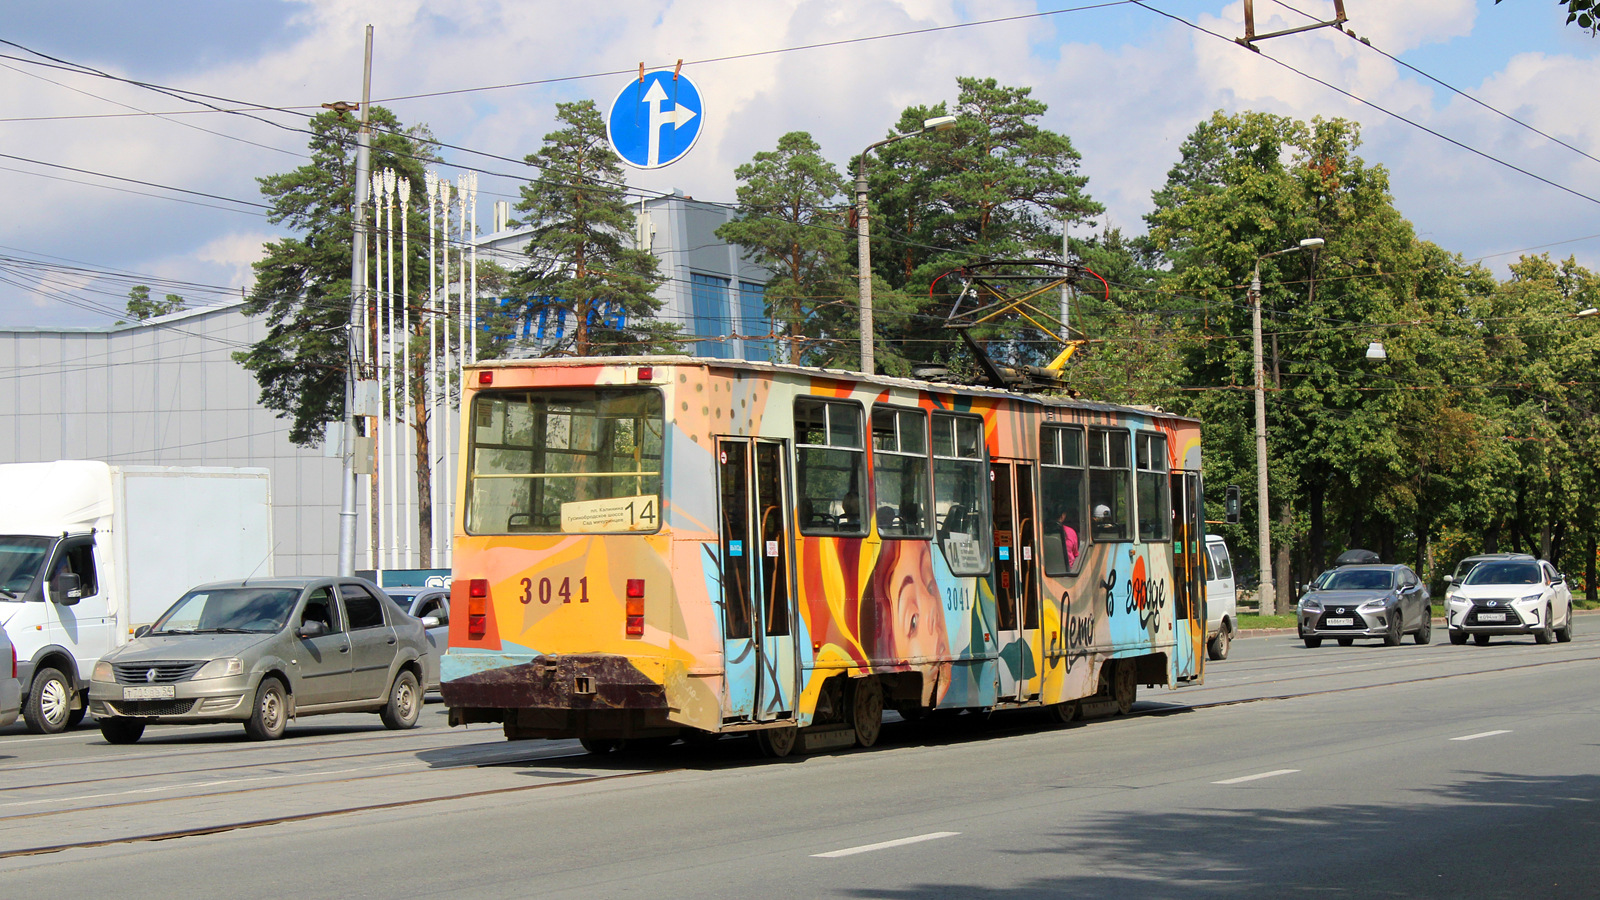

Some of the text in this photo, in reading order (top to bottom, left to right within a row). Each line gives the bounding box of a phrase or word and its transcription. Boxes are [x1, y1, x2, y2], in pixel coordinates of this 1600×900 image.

[625, 500, 656, 526] 14
[948, 542, 960, 568] 14
[519, 576, 590, 605] 3041
[947, 587, 970, 611] 3041
[1050, 591, 1095, 674] Лето
[1126, 577, 1167, 634] городе
